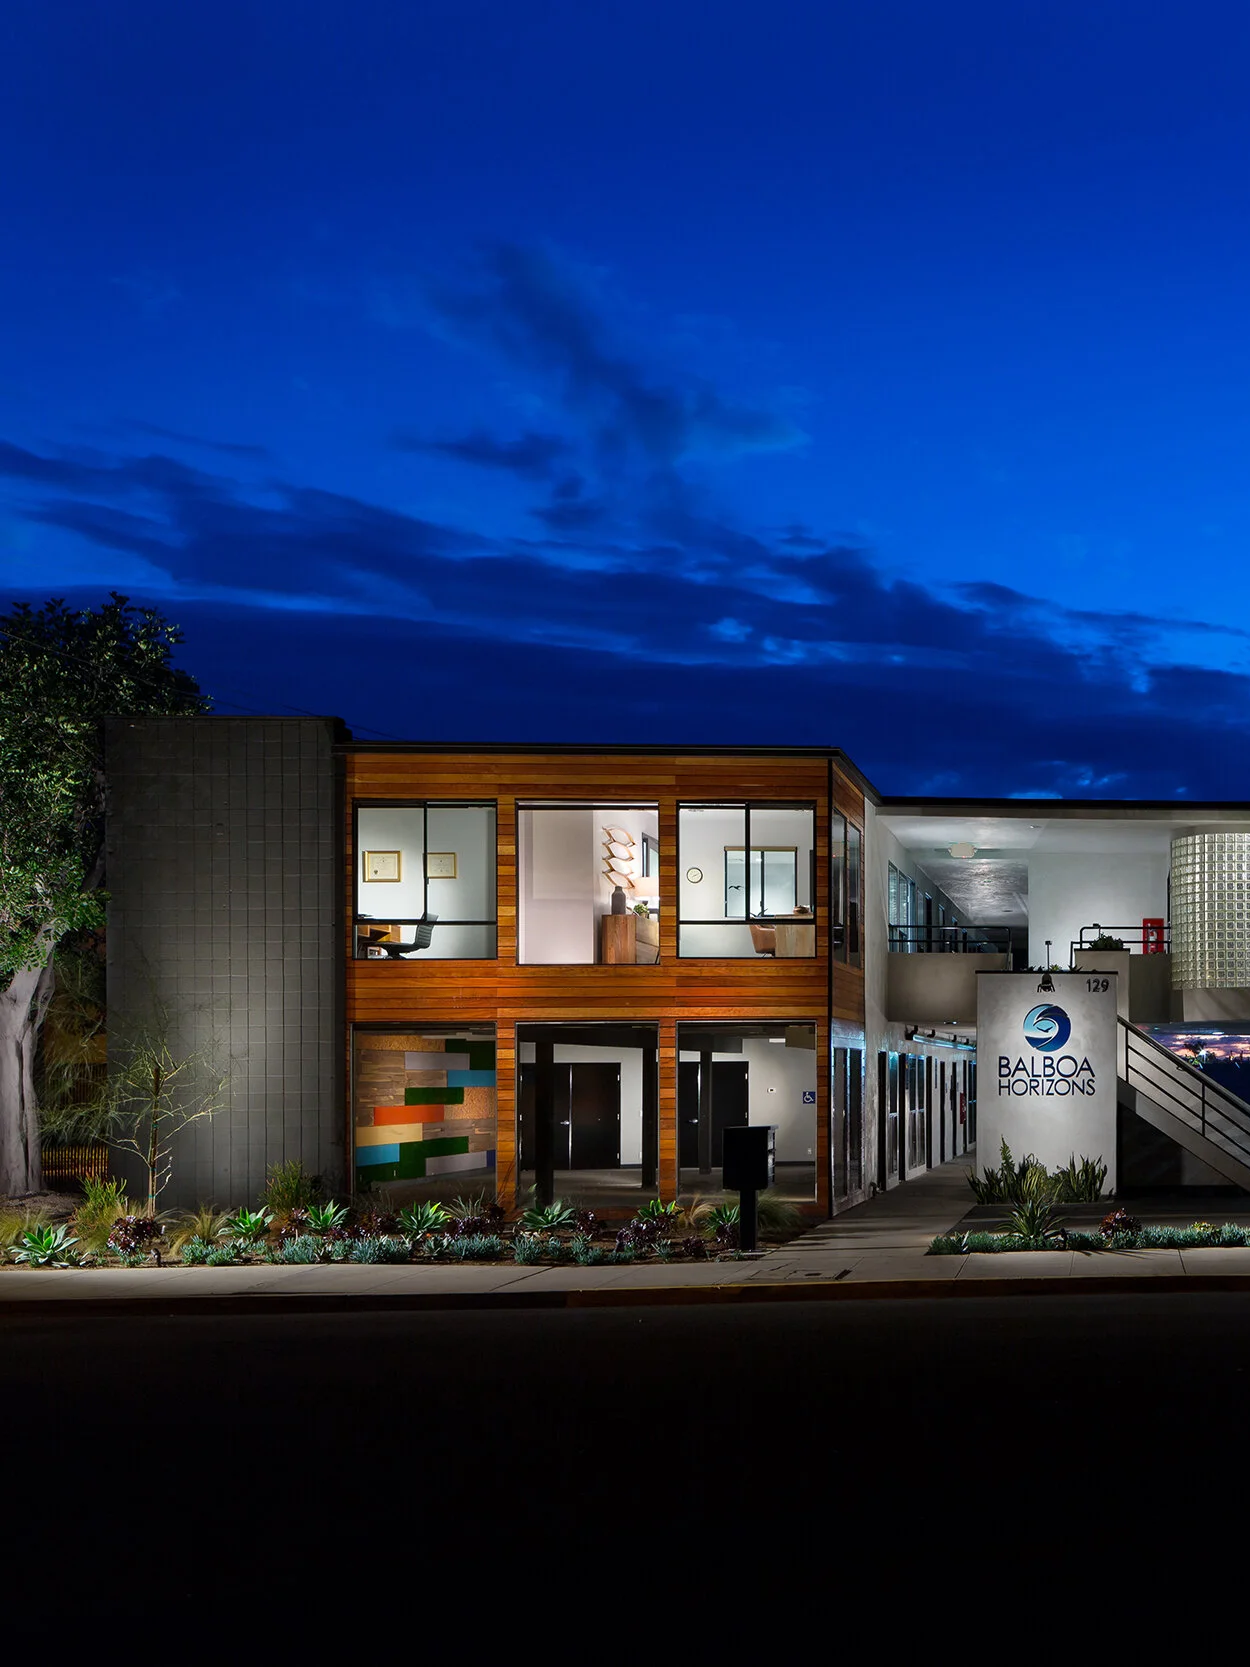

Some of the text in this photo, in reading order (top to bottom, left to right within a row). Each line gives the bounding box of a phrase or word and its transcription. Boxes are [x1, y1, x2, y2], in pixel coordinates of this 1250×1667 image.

[1086, 978, 1110, 993] 129
[998, 1055, 1096, 1078] BALBOA
[998, 1078, 1096, 1097] HORIZONS
